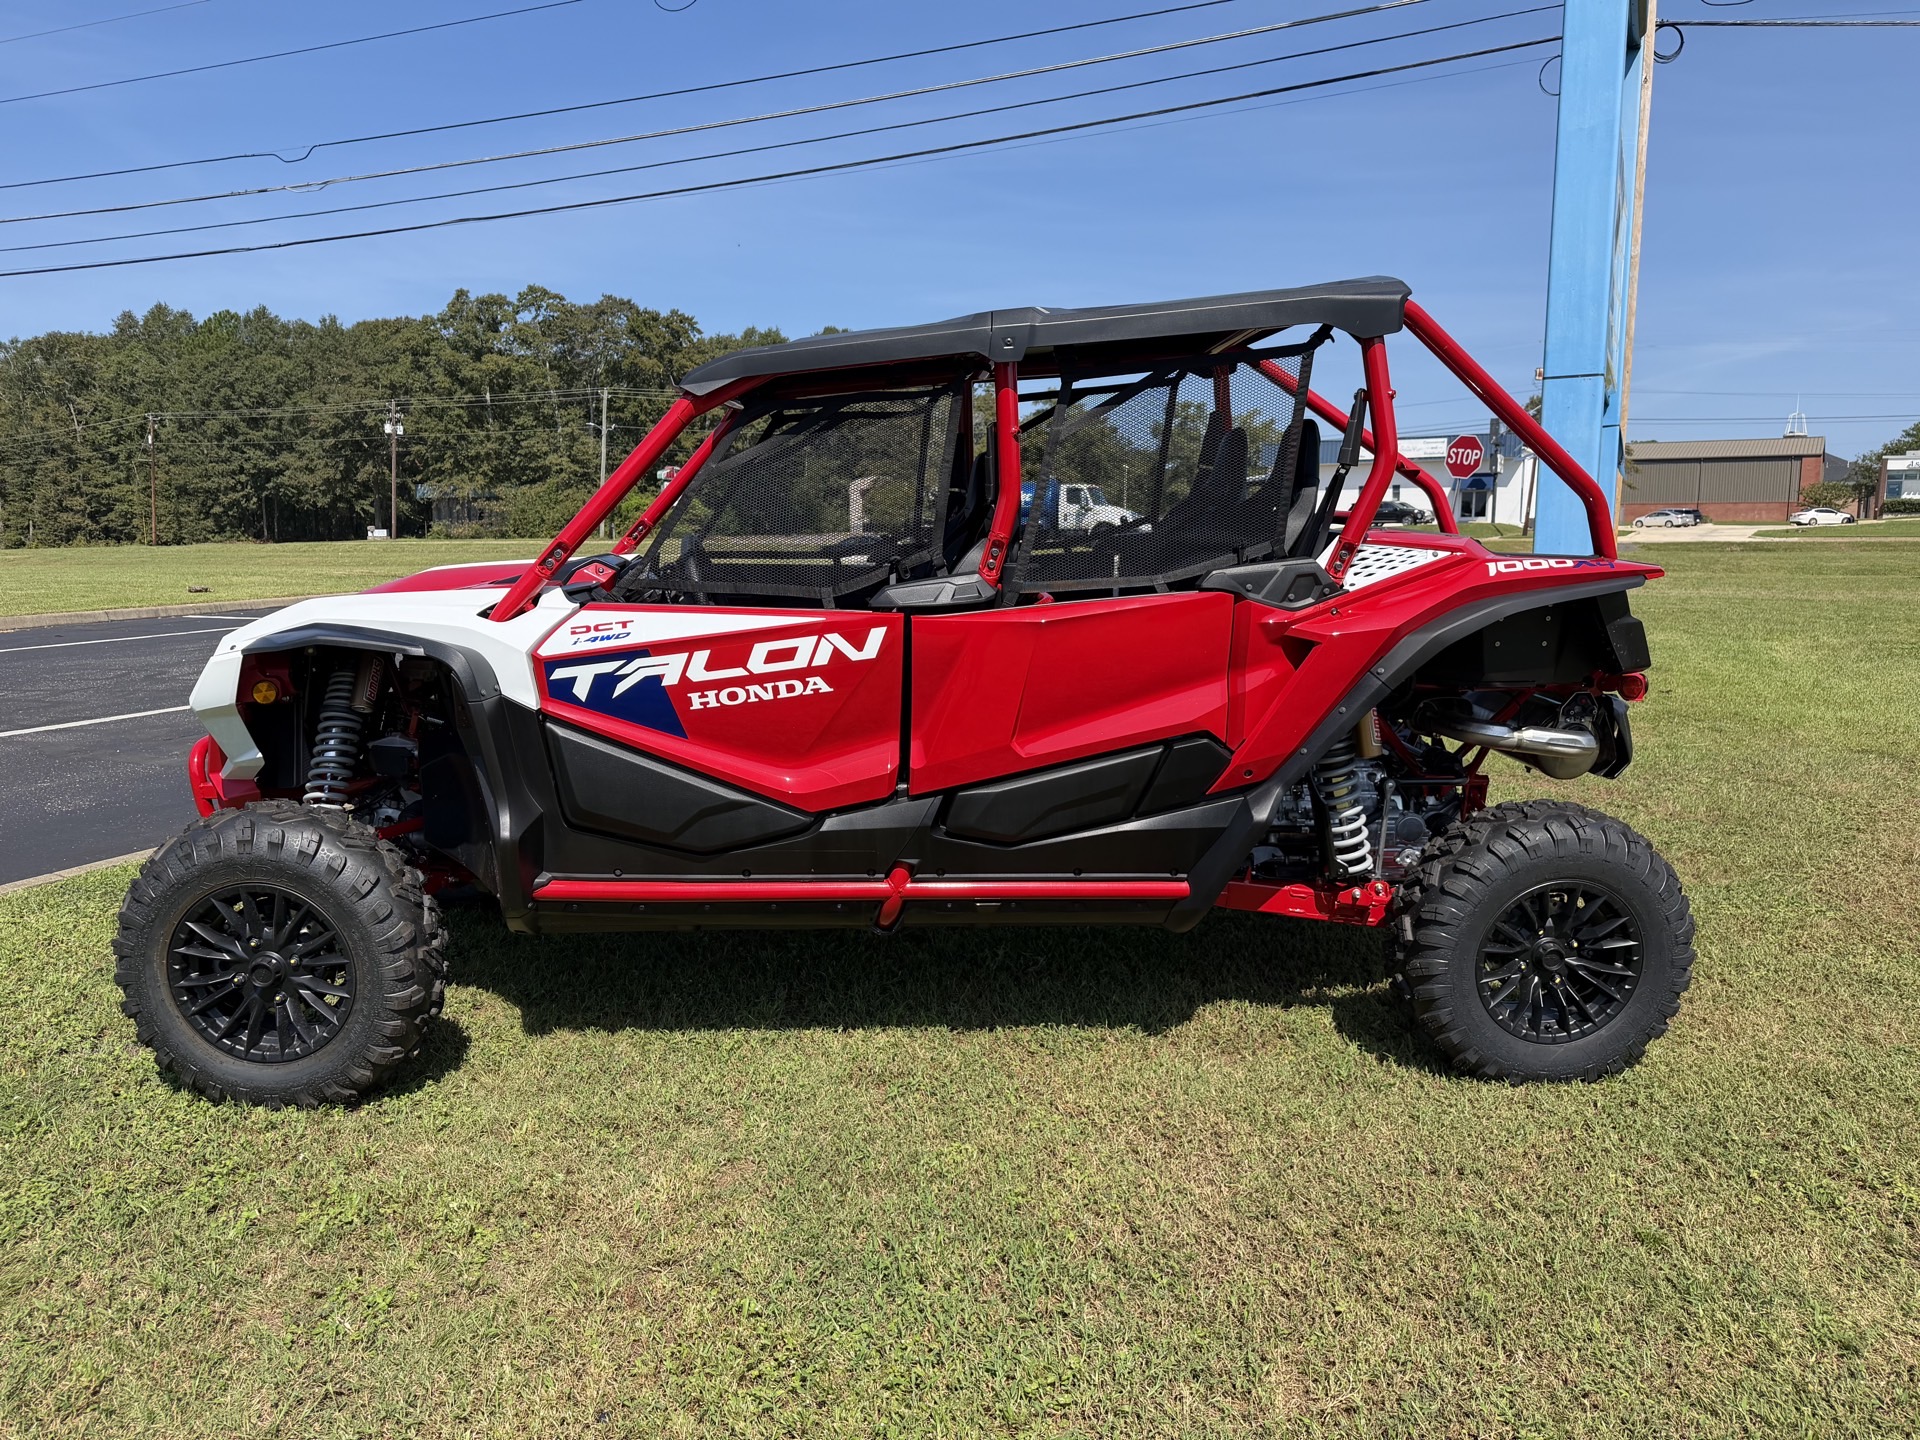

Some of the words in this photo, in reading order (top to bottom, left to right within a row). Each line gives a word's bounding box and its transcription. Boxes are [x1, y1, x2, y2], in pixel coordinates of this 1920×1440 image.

[1448, 448, 1481, 465] STOP
[570, 620, 634, 635] DCT
[366, 657, 384, 701] SHOWA
[549, 626, 888, 702] TALON
[687, 676, 834, 710] HONDA
[196, 863, 296, 895] KENDA
